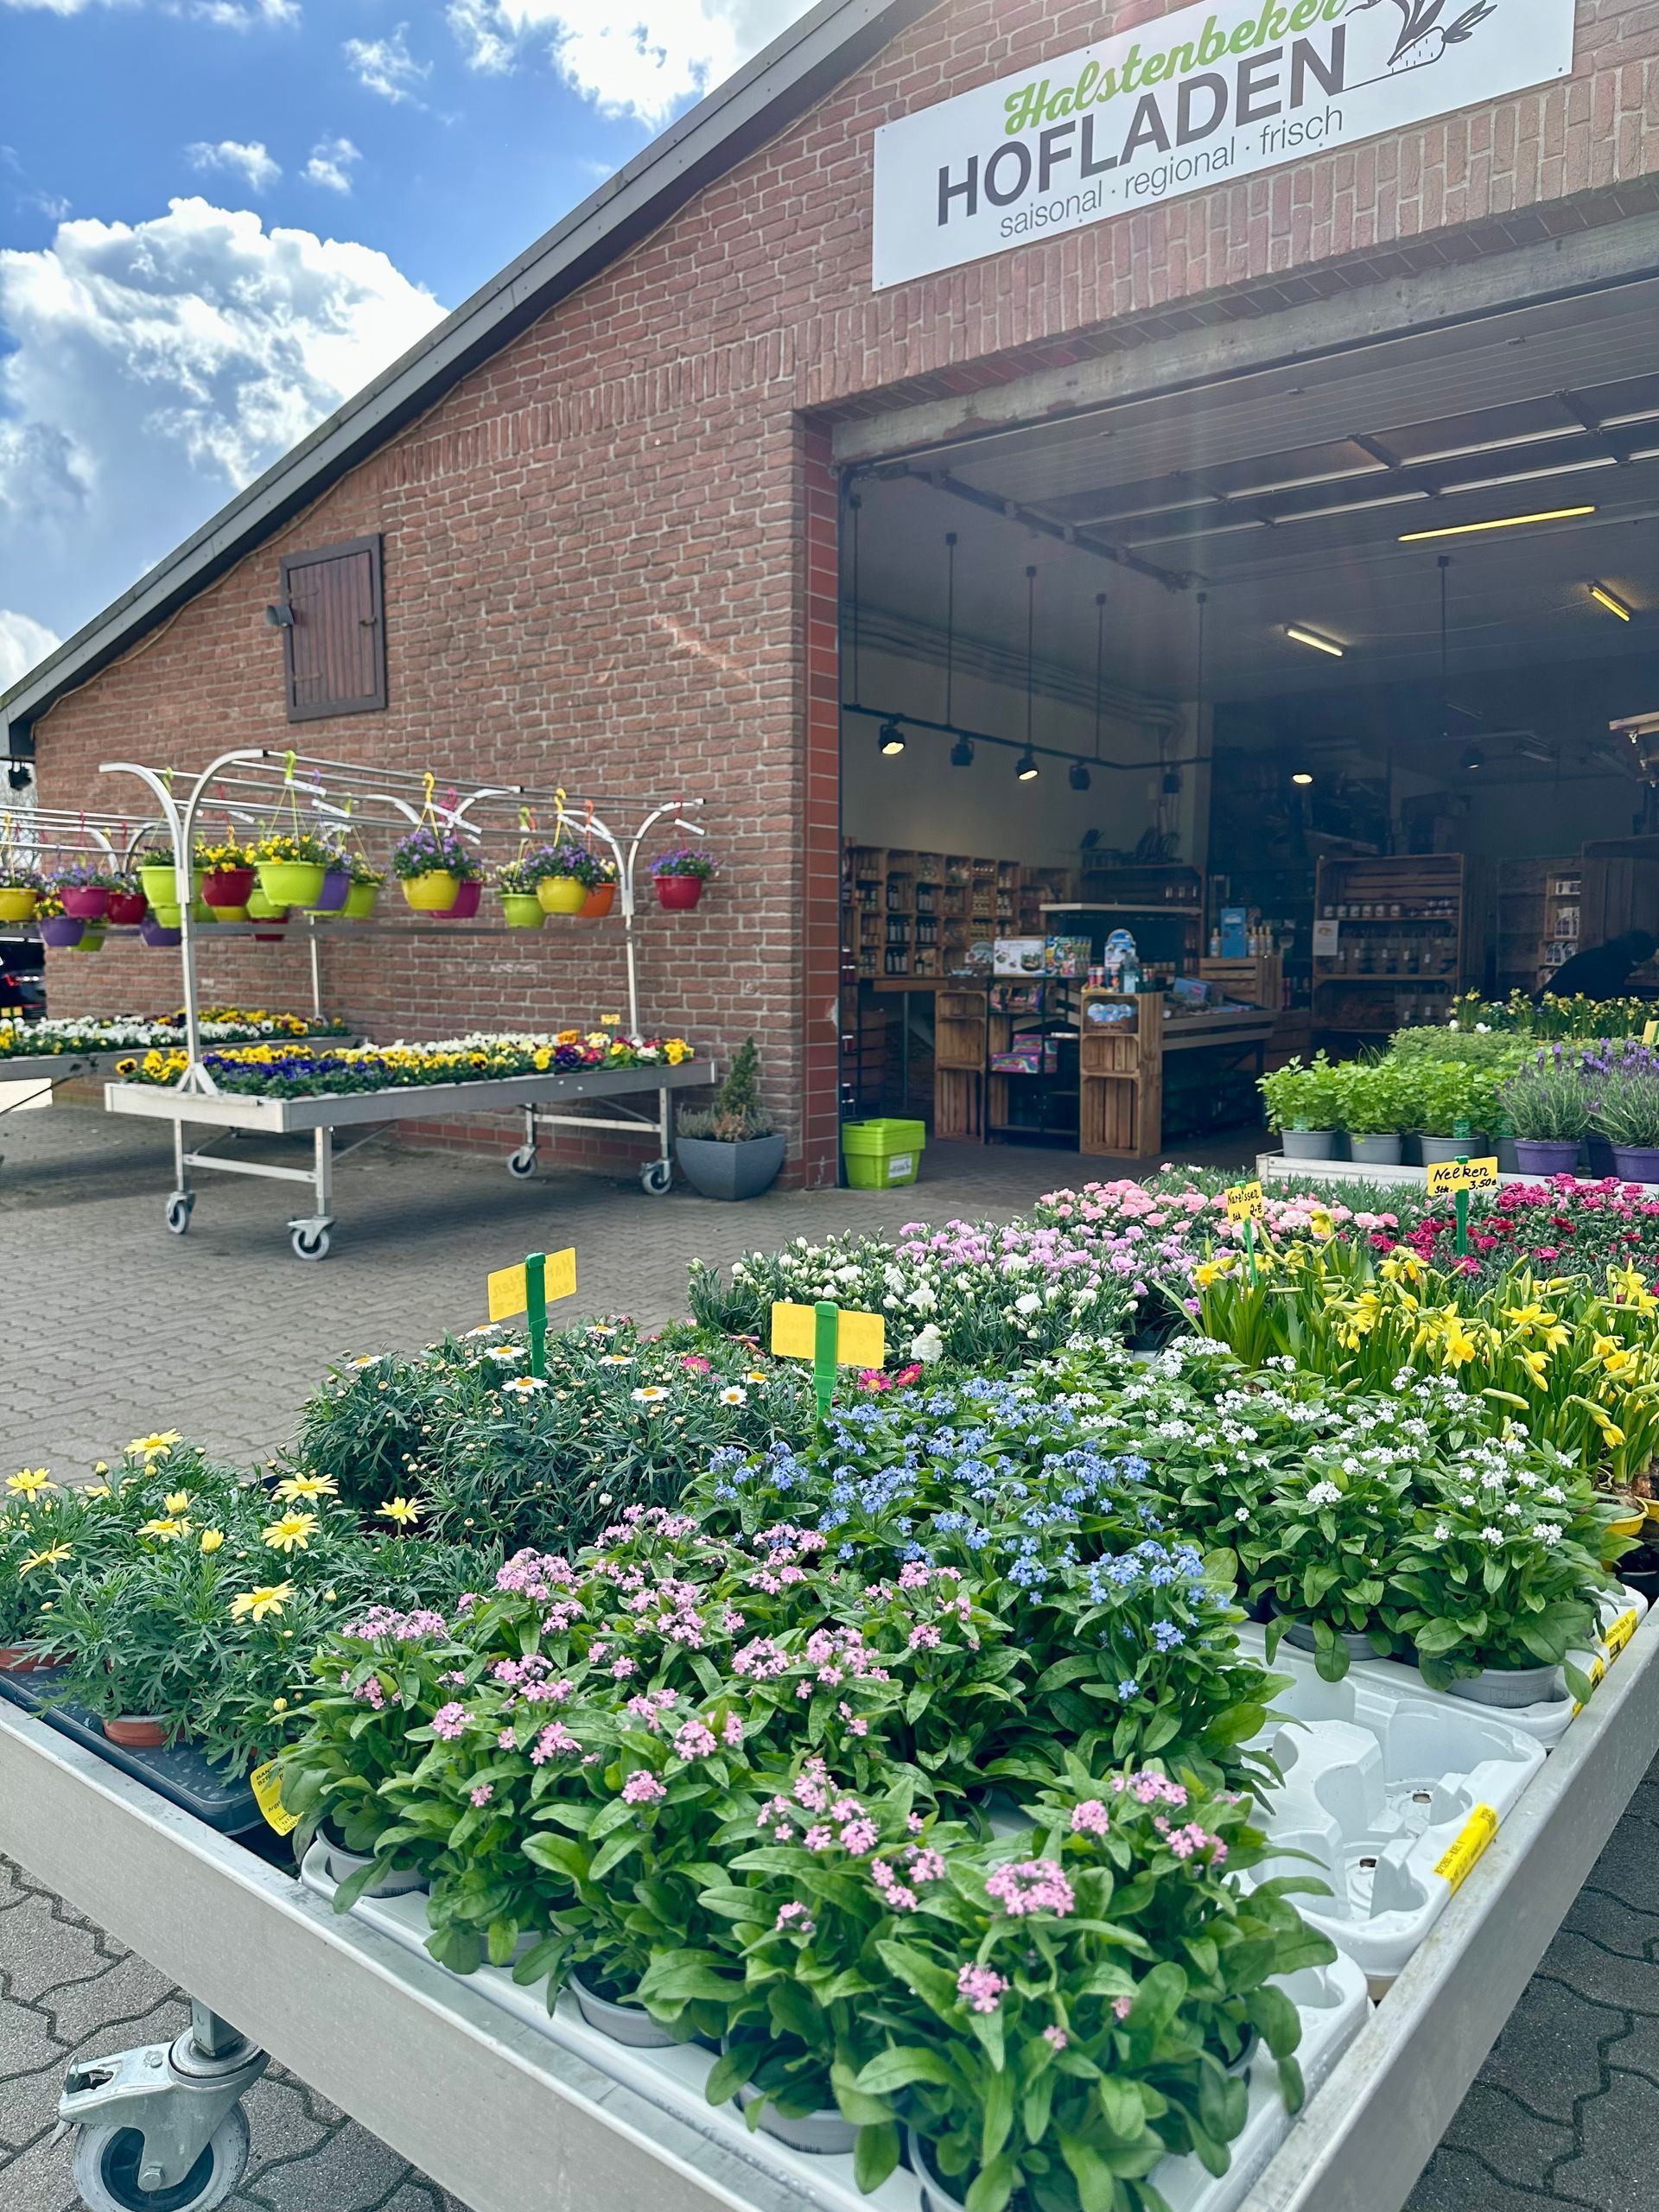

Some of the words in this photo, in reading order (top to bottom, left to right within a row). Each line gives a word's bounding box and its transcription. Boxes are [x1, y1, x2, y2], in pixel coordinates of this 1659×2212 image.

[938, 23, 1346, 226] HOFLADEN
[1004, 0, 1348, 136] Halstenbeker
[1000, 179, 1103, 238] saisonal
[1125, 137, 1235, 199] regional
[1260, 105, 1343, 155] frisch
[1433, 1165, 1489, 1183] Nelken
